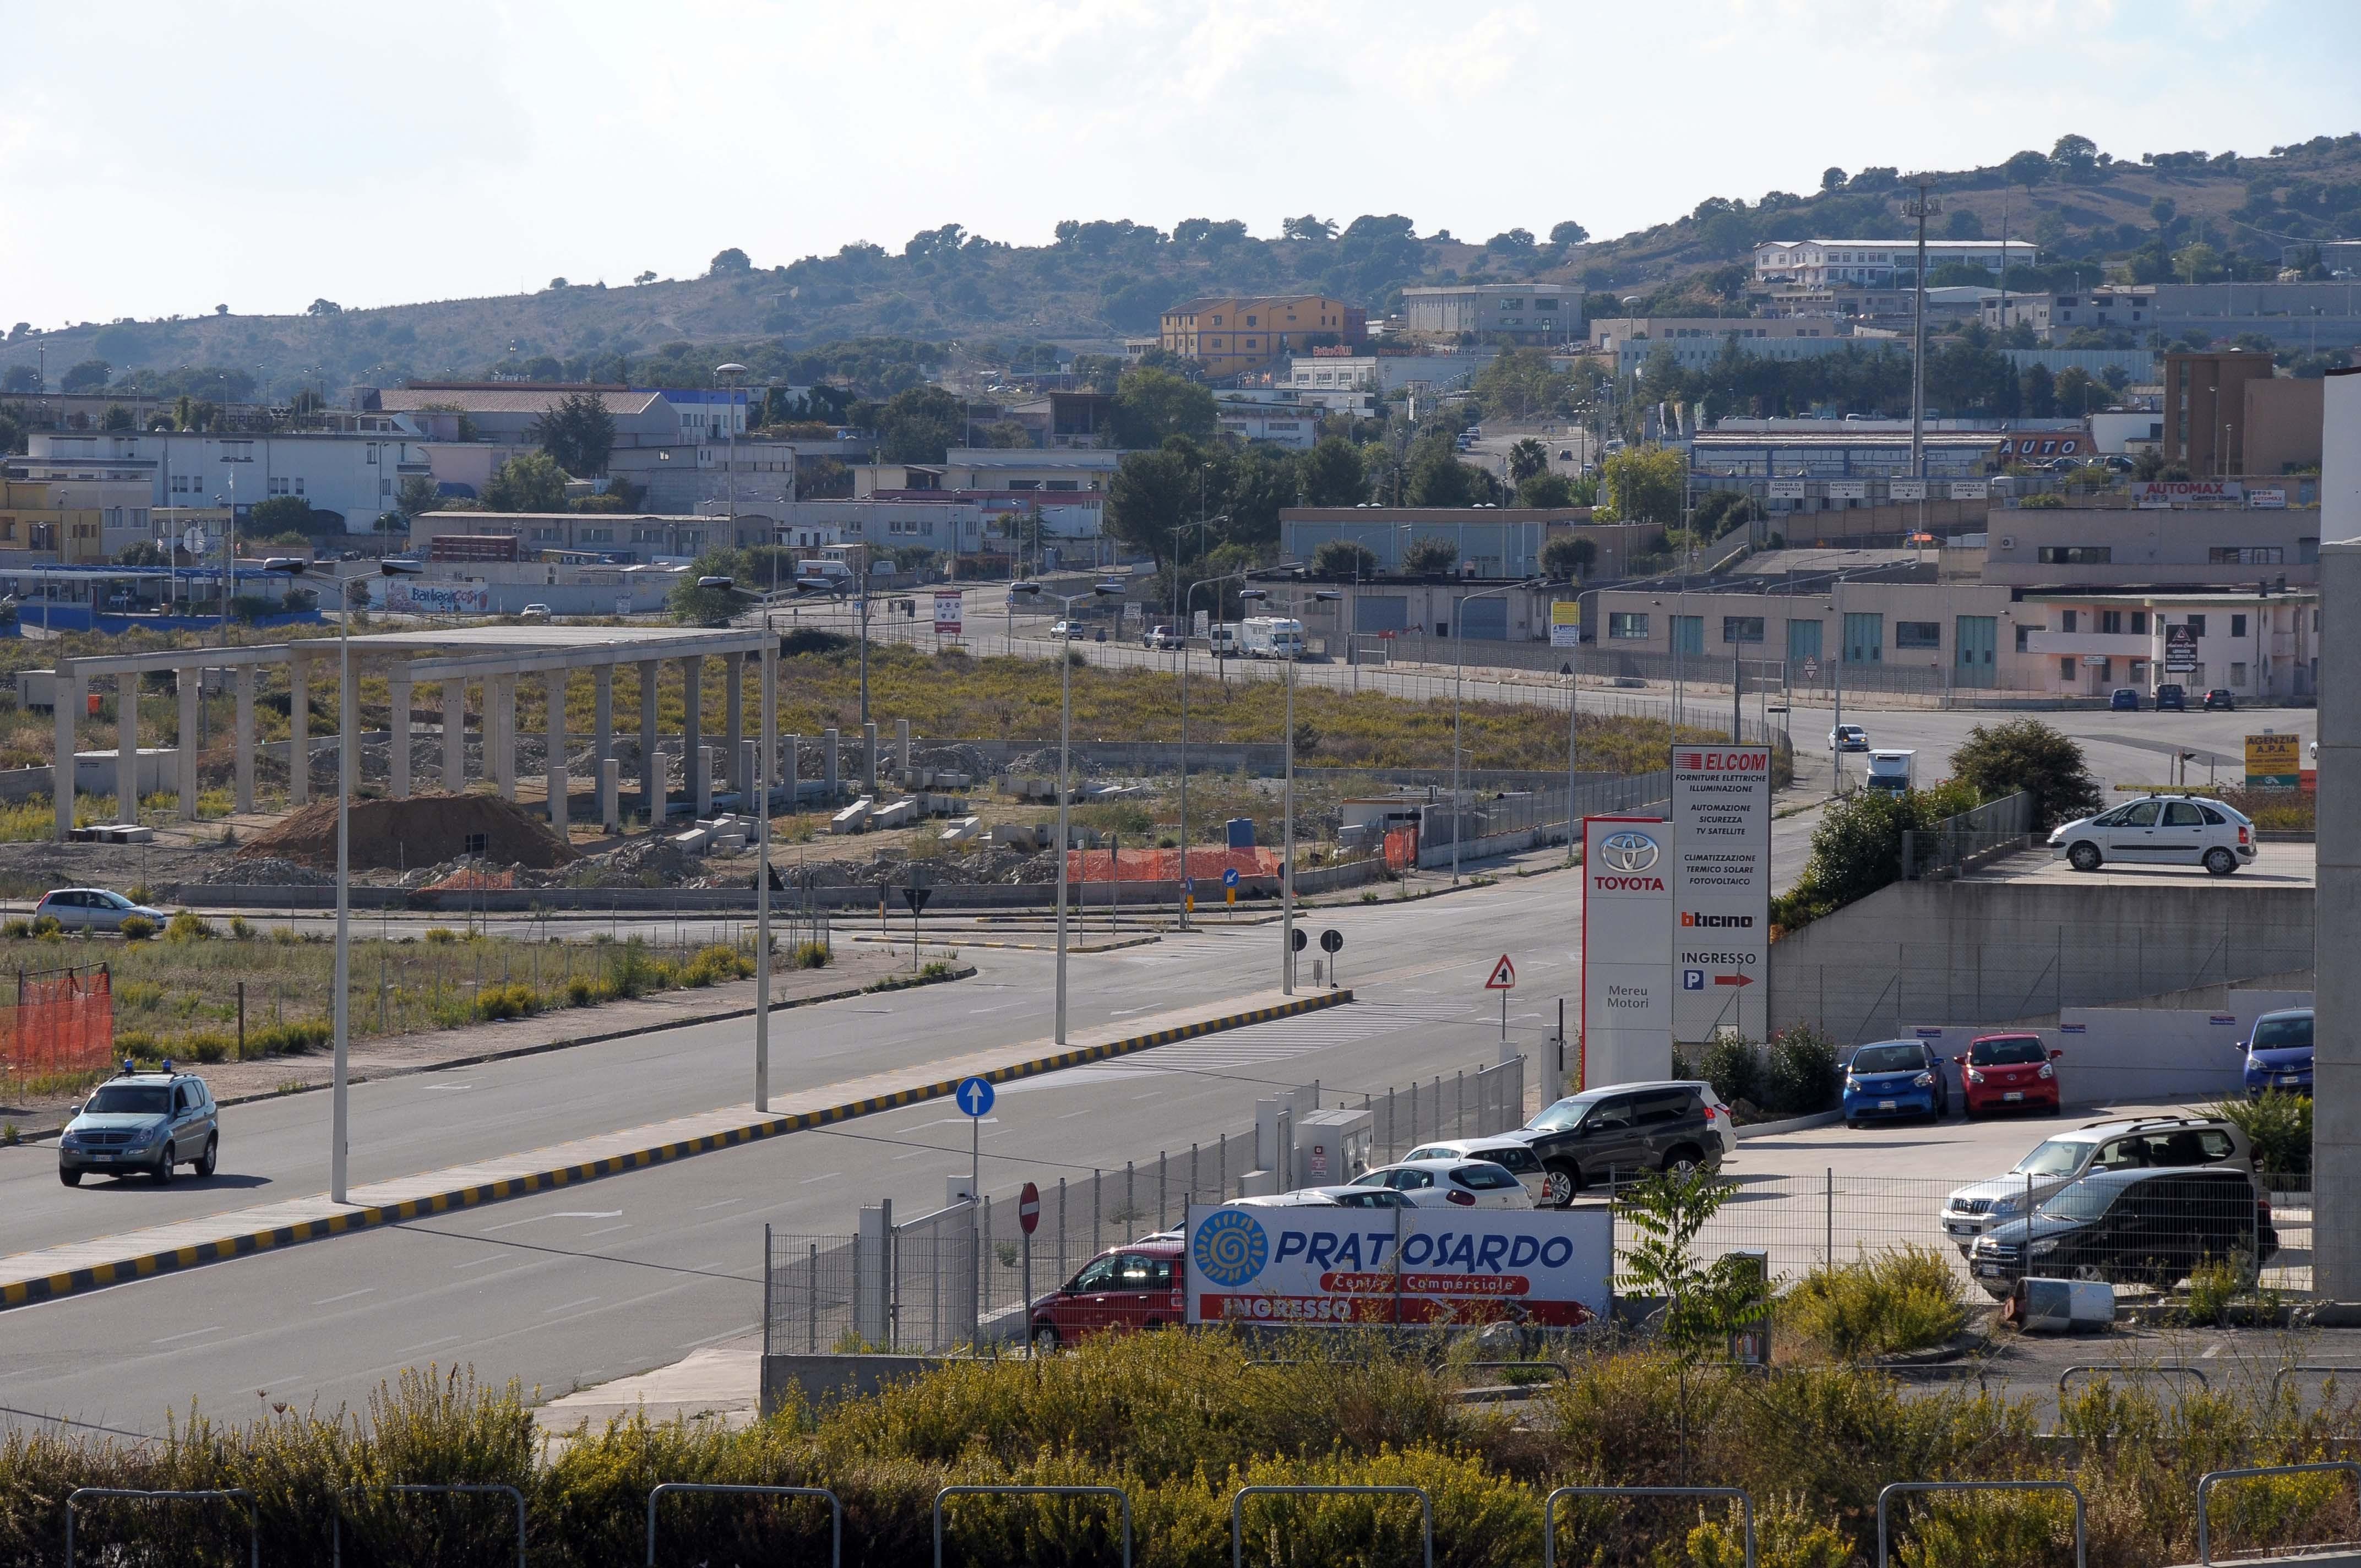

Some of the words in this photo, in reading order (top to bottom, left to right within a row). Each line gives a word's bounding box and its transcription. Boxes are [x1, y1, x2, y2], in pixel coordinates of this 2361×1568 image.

[1999, 441, 2075, 454] AUTO
[2145, 483, 2225, 494] AUTOMAX
[2247, 736, 2298, 745] AGENZIA
[2256, 744, 2290, 753] A.P.A.
[1705, 753, 1767, 771] ELCOM
[1684, 854, 1756, 862] CLIMATIZZAZIONE
[1594, 876, 1664, 891] TOYOTA
[1681, 912, 1754, 928] bticino
[1681, 952, 1757, 965] INGRESSO
[1688, 972, 1700, 988] P
[1609, 985, 1648, 996] Mereu
[1607, 998, 1649, 1008] Motori
[1335, 1275, 1389, 1288] Centro
[1406, 1276, 1514, 1291] Commerciale
[1223, 1298, 1352, 1320] INGRESSO
